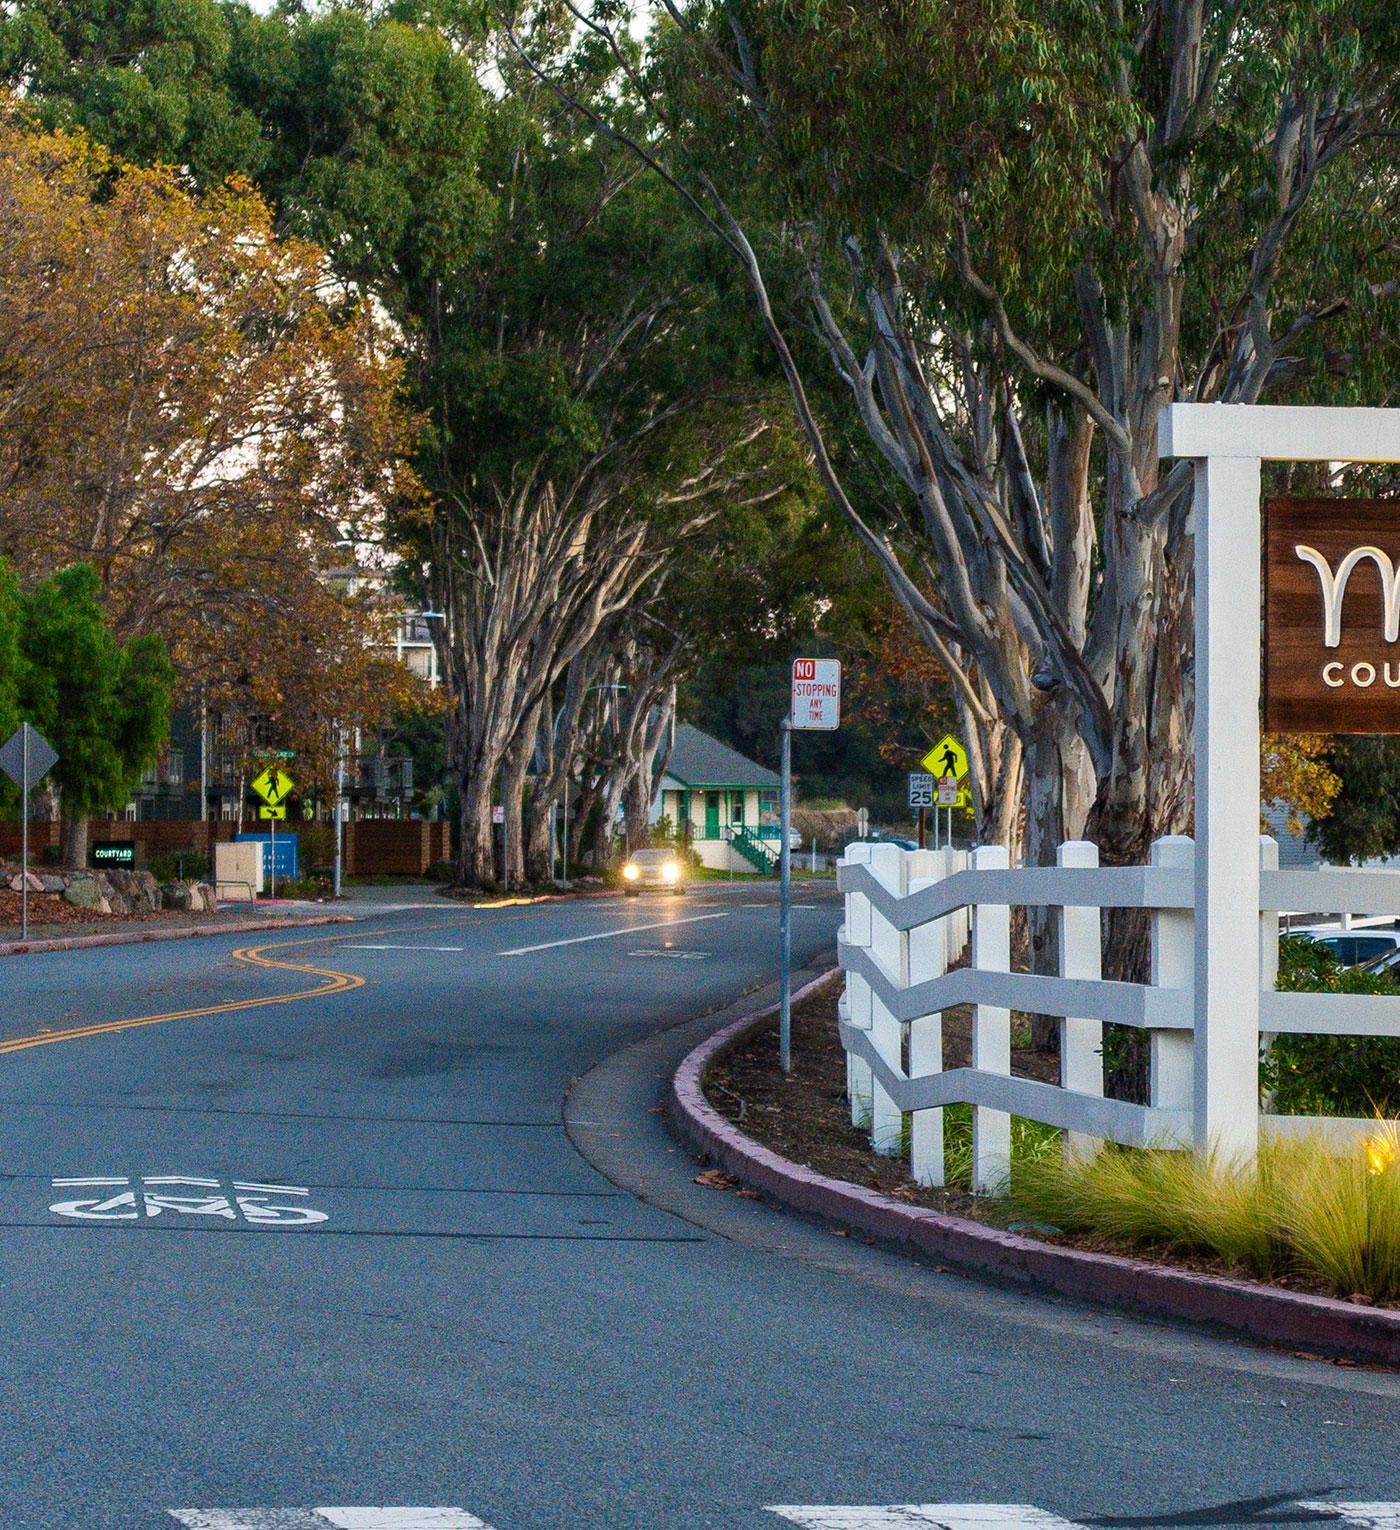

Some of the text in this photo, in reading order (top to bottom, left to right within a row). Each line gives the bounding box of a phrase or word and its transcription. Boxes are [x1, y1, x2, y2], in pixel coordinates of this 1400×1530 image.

[796, 662, 813, 678] NO
[796, 683, 837, 697] STOPPING
[809, 699, 823, 708] ANY
[808, 711, 823, 720] TIME
[911, 791, 932, 804] 25
[95, 850, 132, 858] COURTYARD
